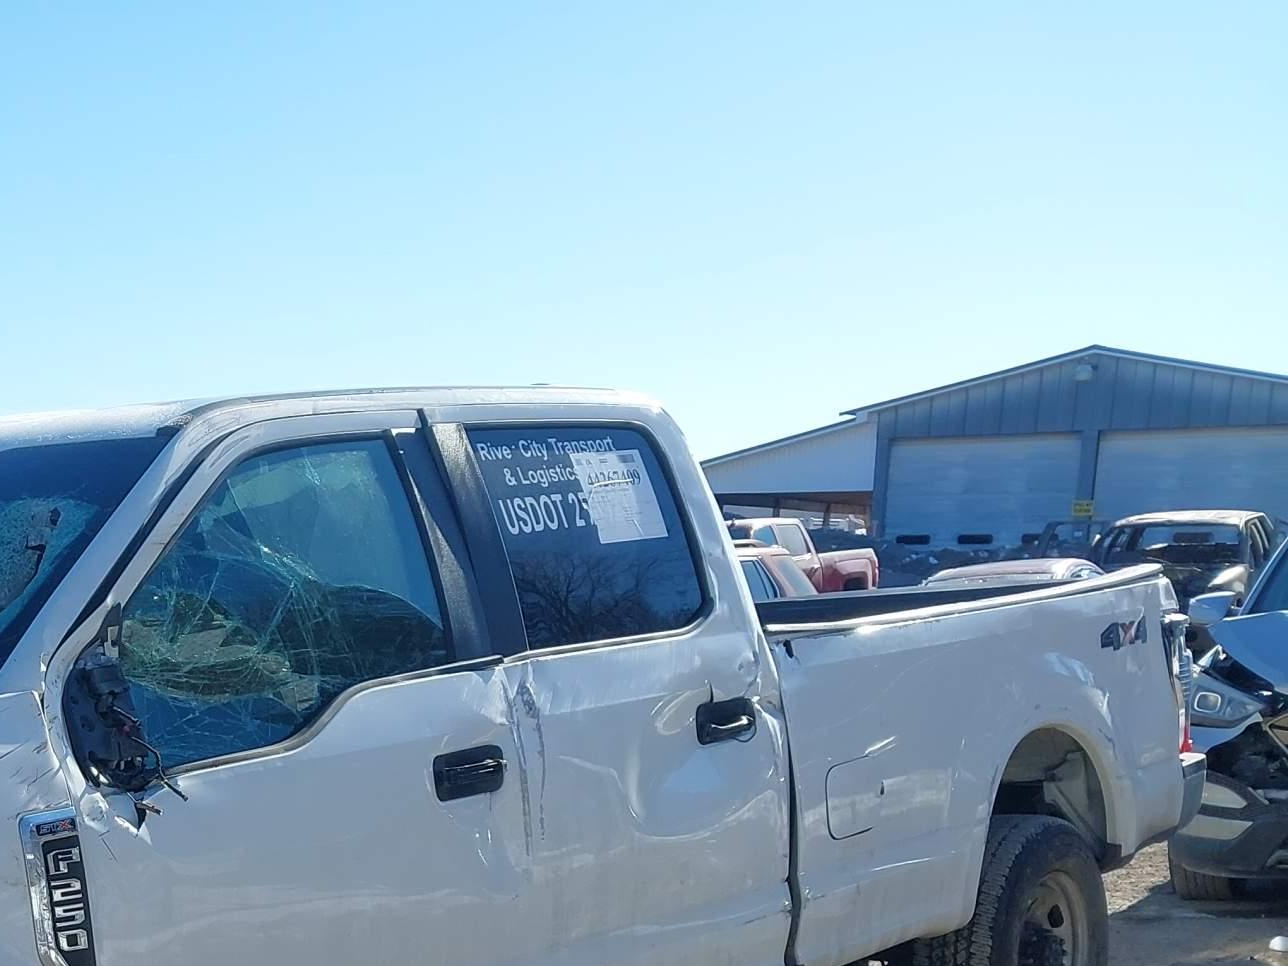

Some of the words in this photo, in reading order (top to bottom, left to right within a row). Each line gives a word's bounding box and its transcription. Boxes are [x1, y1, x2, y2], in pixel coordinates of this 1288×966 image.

[476, 442, 515, 461] Rive
[518, 439, 548, 461] City
[547, 435, 617, 456] Transport
[503, 467, 517, 486] &
[498, 493, 569, 535] USDOT
[46, 846, 89, 952] F250
